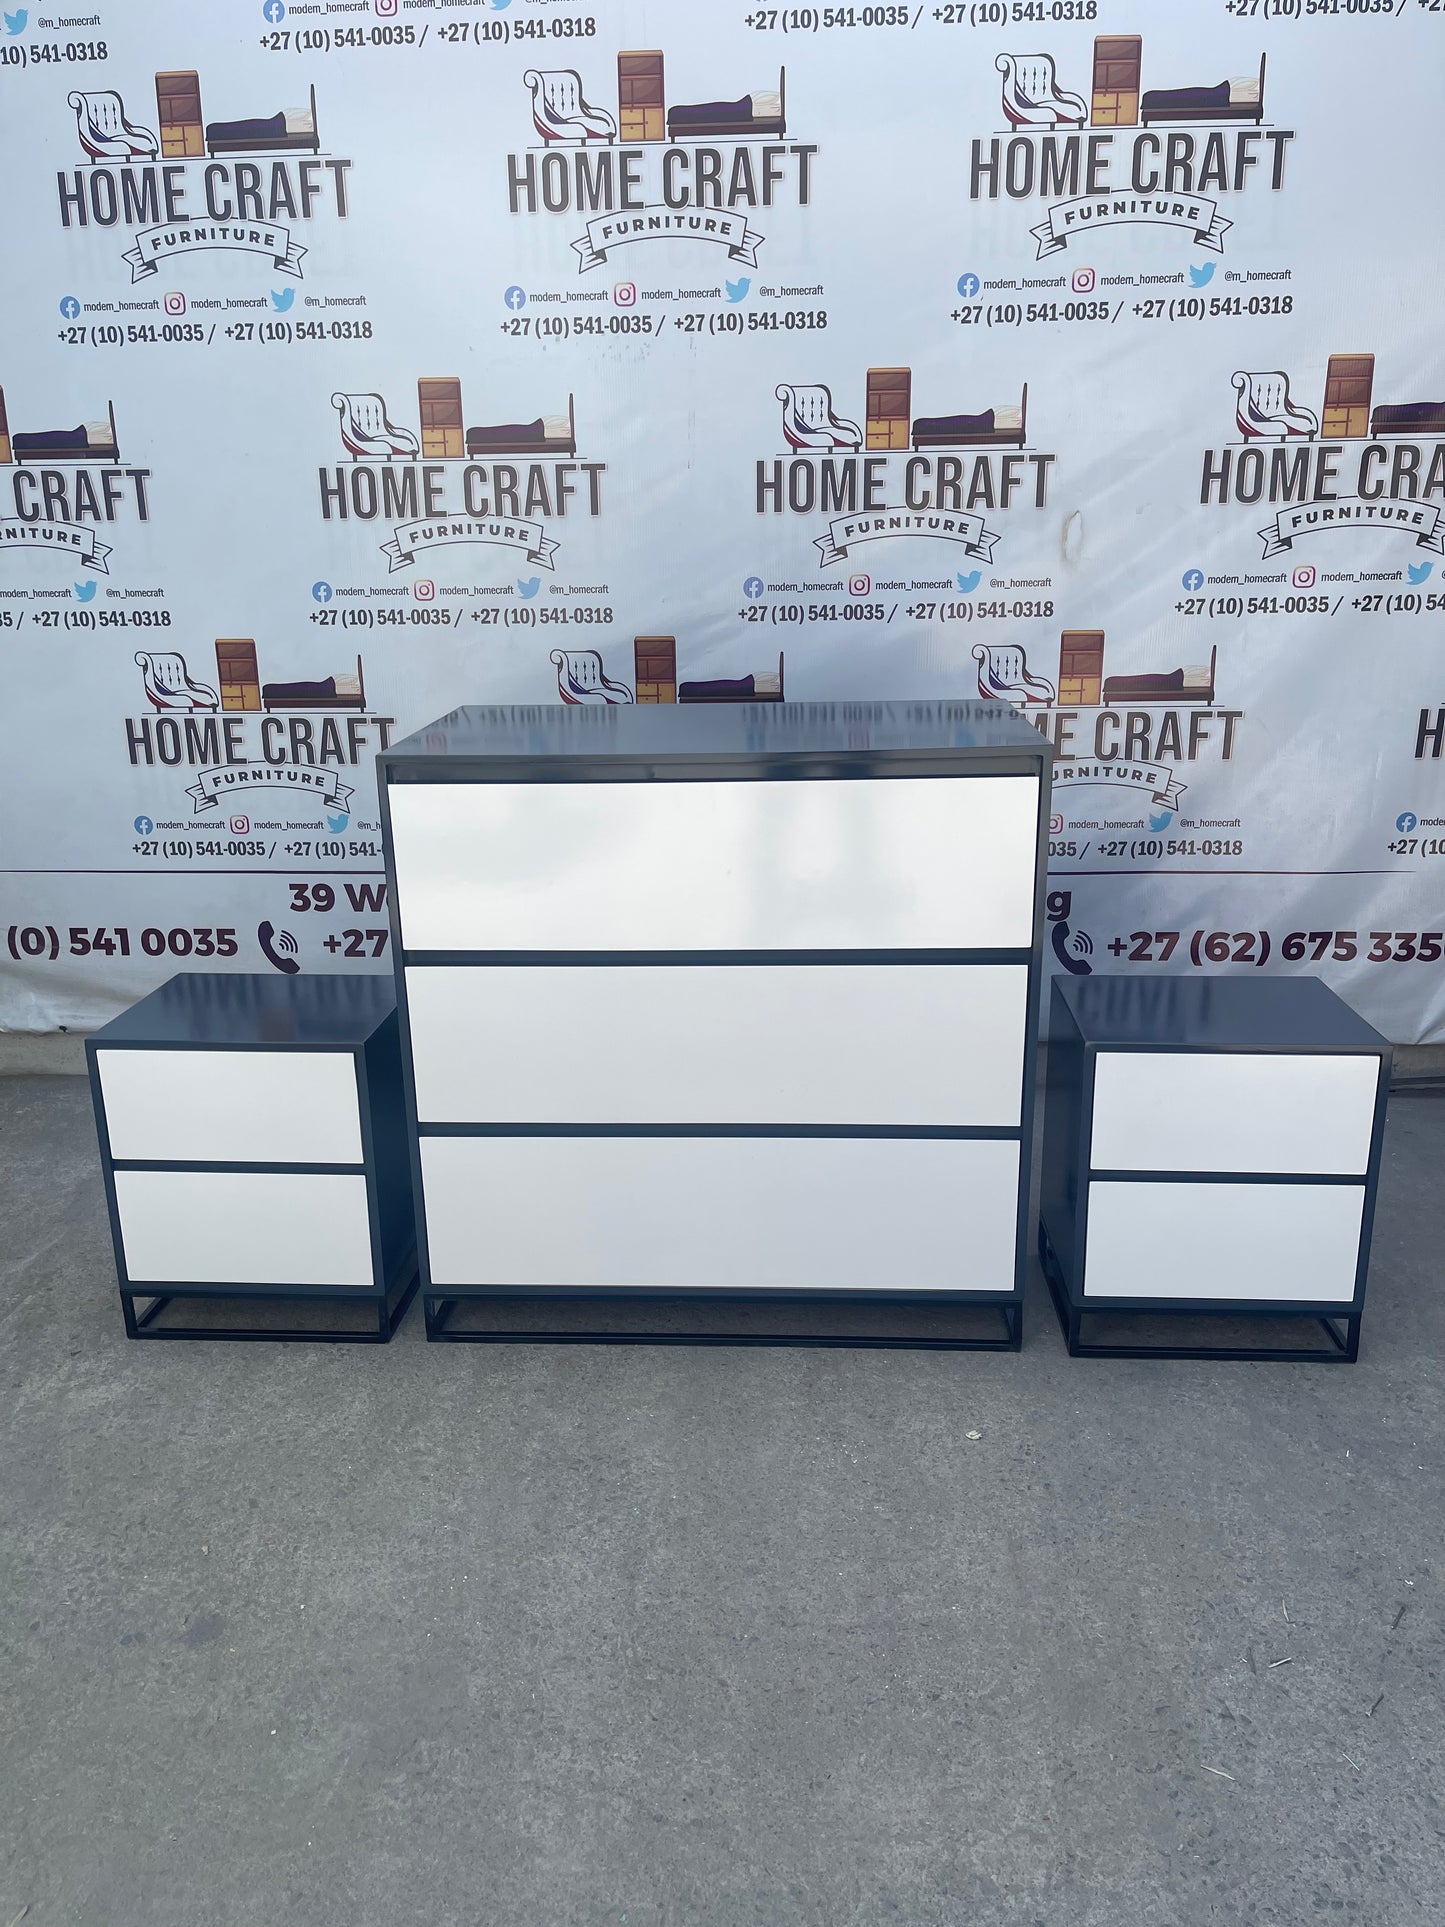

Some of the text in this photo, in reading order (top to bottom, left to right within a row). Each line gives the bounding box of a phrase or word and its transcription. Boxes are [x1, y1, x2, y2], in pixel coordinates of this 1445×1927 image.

[38, 15, 100, 29] @m_homecraft
[745, 11, 777, 30] +27
[783, 9, 818, 33] (10)
[823, 6, 908, 27] 541-0035
[933, 4, 966, 23] +27
[971, 3, 1007, 27] (10)
[1012, 1, 1097, 21] 541-0318
[260, 32, 290, 50] +27
[296, 30, 330, 53] (10)
[335, 26, 415, 47] 541-0035
[438, 23, 469, 42] +27
[474, 21, 509, 45] (10)
[514, 17, 595, 39] 541-0318
[30, 42, 107, 63] 541-0318
[969, 130, 1295, 200] HOME CRAFT
[506, 144, 819, 213] HOME CRAFT
[57, 159, 353, 228] HOME CRAFT
[1062, 200, 1202, 226] FURNITURE
[150, 227, 278, 253] FURNITURE
[601, 214, 733, 241] FURNITURE
[1225, 269, 1291, 282] @m_homecraft
[305, 296, 366, 308] @m_homecraft
[760, 285, 823, 298] @m_homecraft
[951, 306, 982, 324] +27
[987, 305, 1022, 327] (10)
[1026, 302, 1109, 322] 541-0035
[1133, 300, 1165, 318] +27
[1169, 299, 1205, 321] (10)
[1210, 296, 1293, 316] 541-0318
[58, 327, 86, 344] +27
[91, 326, 124, 347] (10)
[128, 324, 203, 342] 541-0035
[225, 323, 254, 340] +27
[259, 323, 292, 344] (10)
[296, 321, 372, 339] 541-0318
[501, 318, 530, 335] +27
[536, 317, 569, 339] (10)
[574, 316, 652, 334] 541-0035
[674, 314, 705, 332] +27
[710, 313, 743, 335] (10)
[748, 311, 827, 330] 541-0318
[755, 454, 1056, 513] HOME CRAFT
[1200, 446, 1344, 504] HOME
[12, 469, 152, 523] CRAFT
[319, 463, 607, 519] HOME CRAFT
[844, 515, 970, 539] FURNITURE
[1291, 505, 1425, 529] FURNITURE
[408, 522, 530, 544] FURNITURE
[106, 588, 164, 599] @m_homecraft
[550, 585, 609, 595] @m_homecraft
[990, 578, 1051, 589] @m_homecraft
[310, 610, 337, 625] +27
[342, 610, 373, 628] (10)
[378, 609, 450, 625] 541-0035
[471, 609, 499, 624] +27
[504, 608, 536, 627] (10)
[540, 608, 613, 623] 541-0318
[738, 606, 767, 621] +27
[772, 605, 804, 625] (10)
[808, 604, 884, 621] 541-0035
[906, 603, 936, 619] +27
[940, 603, 973, 622] (10)
[977, 601, 1053, 618] 541-0318
[1175, 599, 1205, 614] +27
[1209, 598, 1243, 618] (10)
[1247, 596, 1329, 613] 541-0035
[1352, 595, 1383, 611] +27
[1386, 594, 1421, 615] (10)
[32, 611, 59, 626] +27
[64, 611, 95, 630] (10)
[99, 611, 171, 626] 541-0318
[125, 717, 396, 766] HOME CRAFT
[1094, 711, 1244, 762] CRAFT
[211, 769, 326, 789] FURNITURE
[1179, 819, 1240, 829] @m_homecraft
[133, 842, 158, 855] +27
[163, 842, 192, 858] (10)
[196, 841, 265, 855] 541-0035
[285, 842, 311, 856] +27
[316, 842, 345, 859] (10)
[1098, 842, 1127, 856] +27
[1131, 841, 1163, 859] (10)
[1167, 840, 1242, 855] 541-0318
[1388, 839, 1418, 854] +27
[289, 884, 335, 912] 39
[8, 926, 388, 960] (0) 541 0035 +27
[1108, 931, 1445, 966] +27 (62) 675 335
